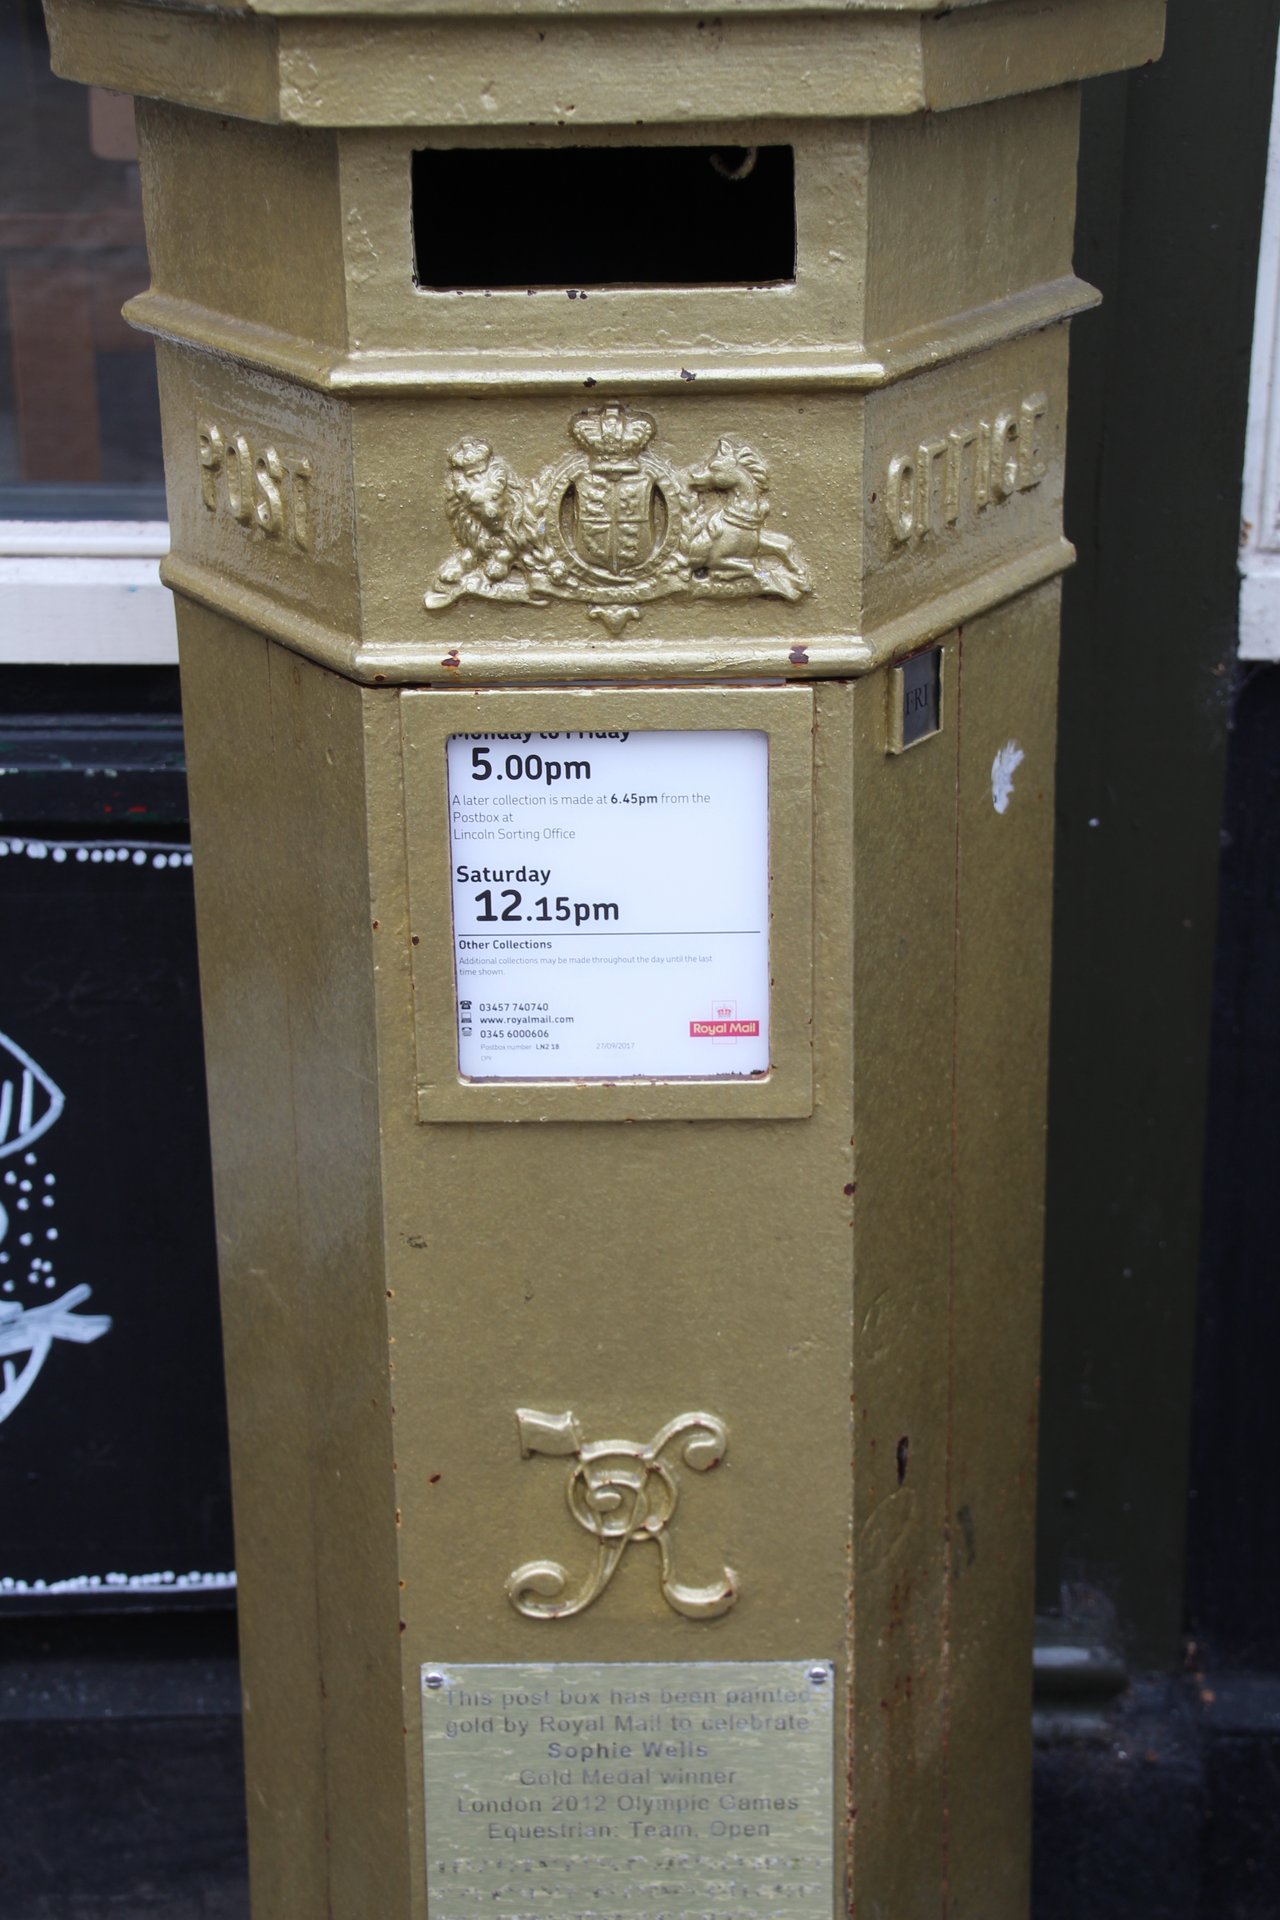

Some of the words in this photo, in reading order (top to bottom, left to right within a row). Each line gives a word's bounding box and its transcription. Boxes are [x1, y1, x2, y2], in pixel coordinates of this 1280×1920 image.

[885, 391, 1047, 548] OFFICE
[198, 424, 314, 551] POST
[906, 683, 929, 715] FRI
[471, 747, 591, 785] 5.00pm
[452, 794, 461, 806] A
[463, 794, 490, 806] later
[492, 794, 547, 805] collection
[549, 793, 559, 805] is
[561, 794, 594, 805] made
[596, 794, 607, 805] at
[610, 792, 659, 806] 6.45pm
[660, 792, 689, 804] from
[691, 792, 711, 804] the
[453, 811, 500, 823] Postbox
[502, 812, 514, 822] at
[453, 828, 495, 840] Lincoln
[497, 827, 540, 841] Sorting
[543, 827, 576, 840] Office
[456, 865, 551, 885] Saturday
[474, 889, 620, 927] 12.15pm
[459, 939, 490, 950] Other
[492, 939, 552, 949] Collections
[459, 957, 497, 965] Additional
[499, 956, 538, 965] collections
[540, 957, 556, 966] may
[558, 956, 567, 964] be
[569, 956, 591, 964] made
[592, 956, 635, 966] throughout
[636, 955, 650, 964] the
[651, 955, 665, 965] day
[666, 955, 683, 963] until
[684, 955, 698, 963] the
[698, 955, 713, 963] last
[459, 968, 477, 976] time
[480, 1002, 510, 1012] 03457
[512, 1002, 549, 1012] 740740
[479, 1014, 575, 1026] www.royalmail.com
[693, 1022, 727, 1036] Royal
[729, 1022, 755, 1033] Mail
[480, 1029, 505, 1038] 0345
[506, 1029, 549, 1038] 6000606
[480, 1043, 506, 1051] Postbox
[506, 1043, 532, 1051] number
[446, 1689, 493, 1706] This
[502, 1688, 550, 1710] post
[560, 1688, 601, 1705] box
[610, 1688, 651, 1705] has
[660, 1687, 717, 1704] been
[726, 1686, 811, 1707] painted
[446, 1717, 495, 1738] gold
[503, 1717, 530, 1737] by
[539, 1716, 605, 1736] Royal
[614, 1714, 662, 1732] Mail
[670, 1714, 693, 1732] to
[702, 1714, 811, 1731] celebrate
[547, 1741, 633, 1762] Sophie
[641, 1740, 709, 1758] Wells
[519, 1768, 573, 1786] Gold
[581, 1768, 651, 1785] Medal
[659, 1768, 738, 1784] winner
[456, 1795, 543, 1813] London
[551, 1794, 607, 1812] 2012
[616, 1794, 711, 1815] Olympic
[718, 1793, 799, 1811] Games
[709, 1819, 771, 1839] Open
